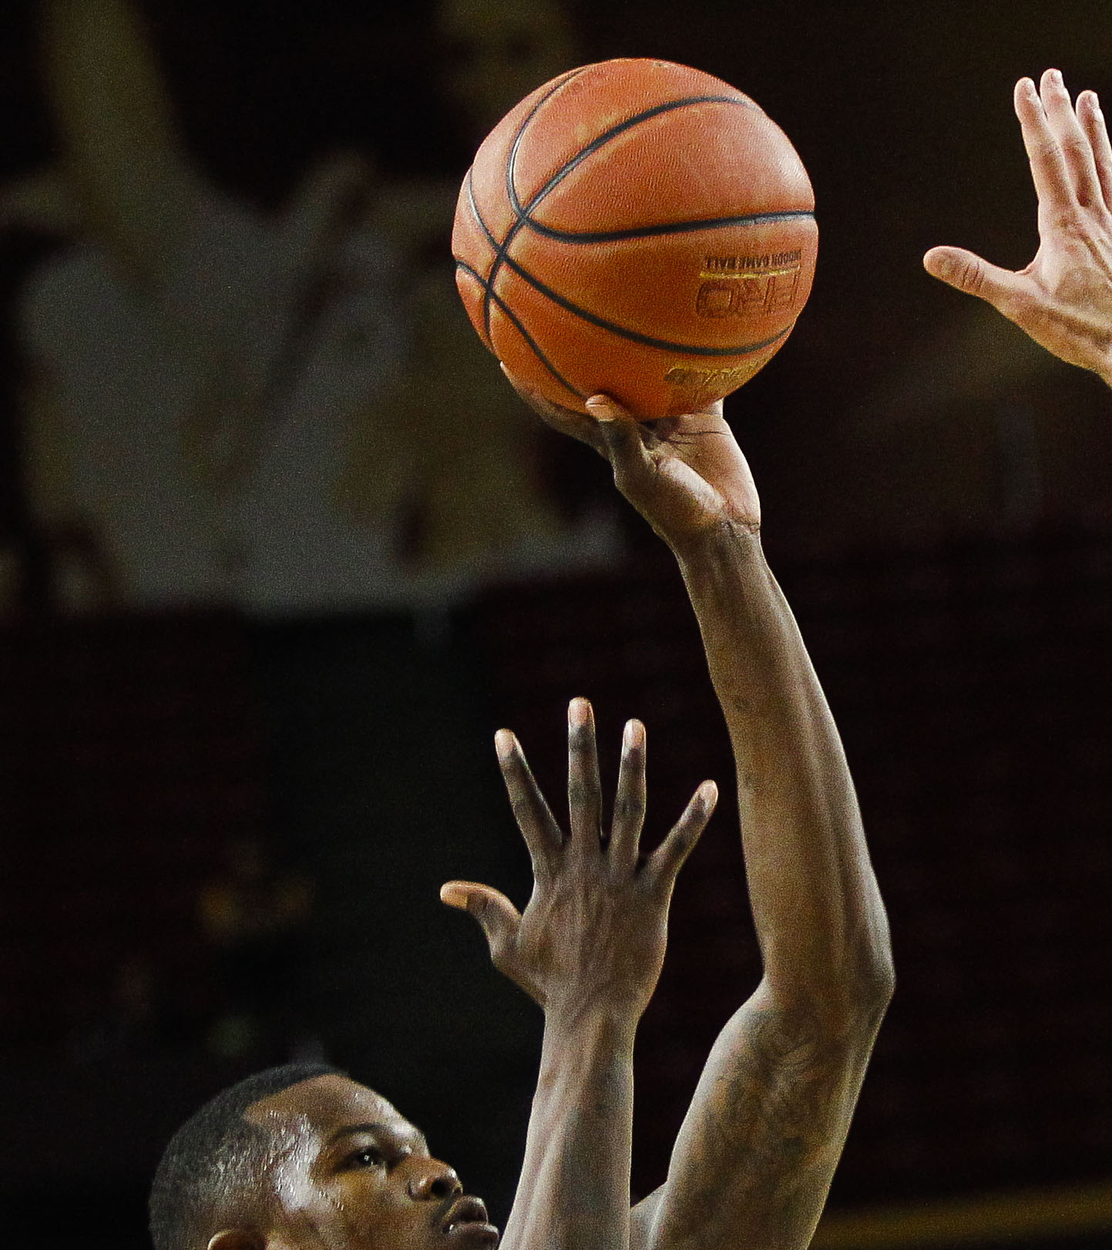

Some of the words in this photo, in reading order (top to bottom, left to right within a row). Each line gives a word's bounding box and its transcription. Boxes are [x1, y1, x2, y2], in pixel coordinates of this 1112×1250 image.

[703, 256, 737, 270] BALL
[740, 256, 769, 270] GAME
[696, 275, 801, 319] PRO
